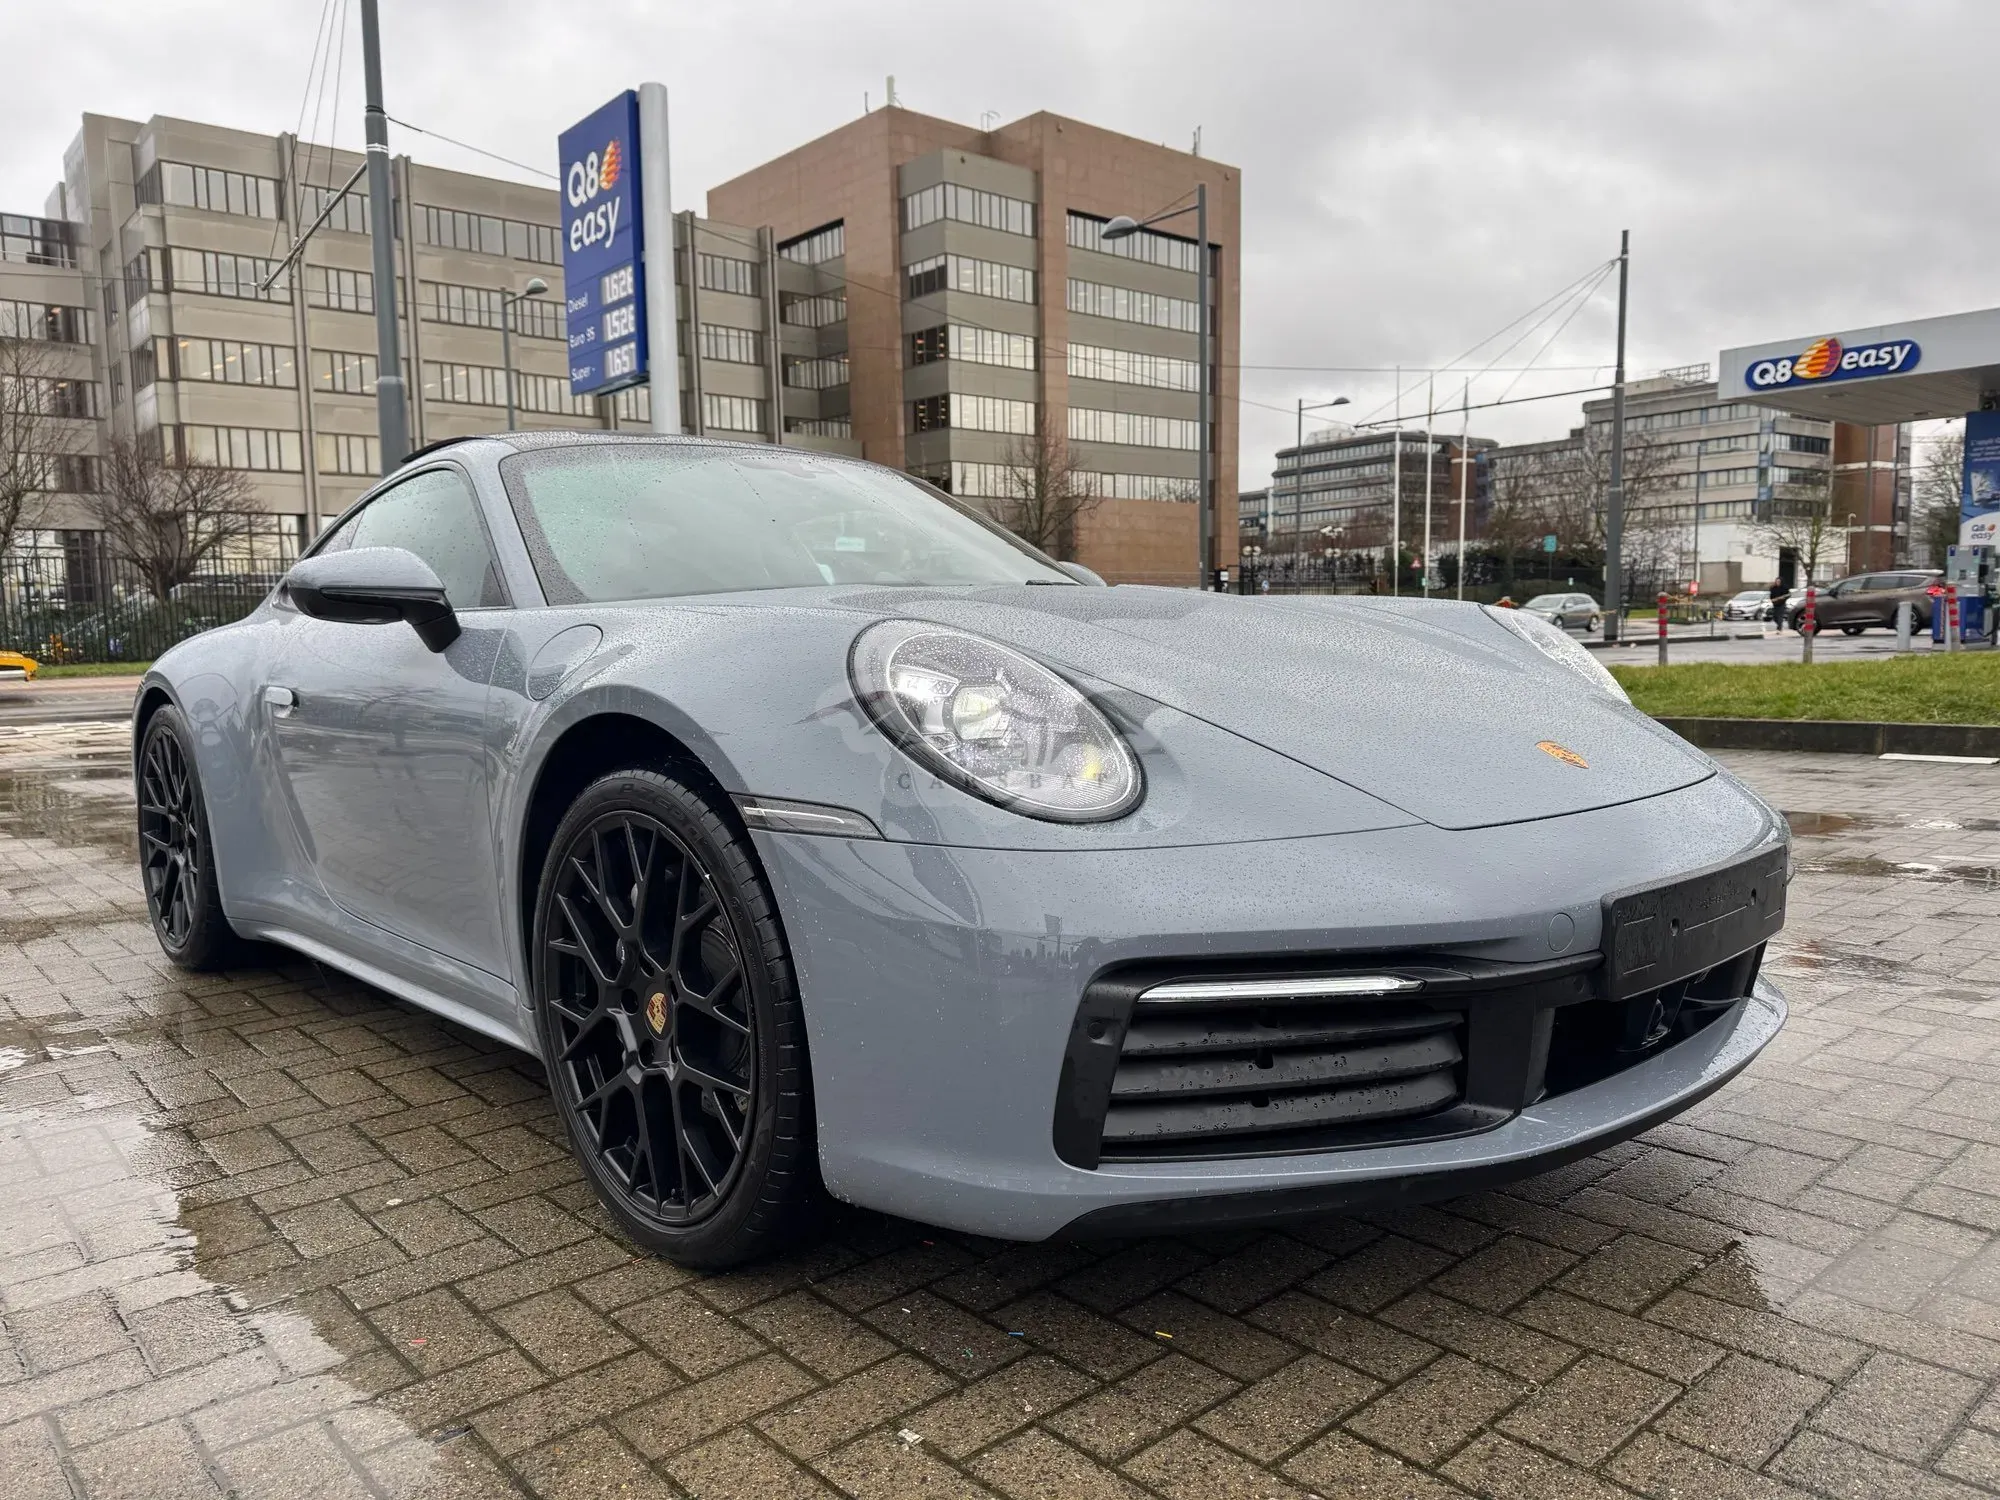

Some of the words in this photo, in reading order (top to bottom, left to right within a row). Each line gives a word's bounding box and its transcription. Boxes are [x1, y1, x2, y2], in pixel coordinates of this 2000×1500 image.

[567, 151, 599, 208] Q8
[570, 196, 620, 252] easy
[1752, 361, 1793, 385] Q8
[1841, 343, 1912, 371] easy
